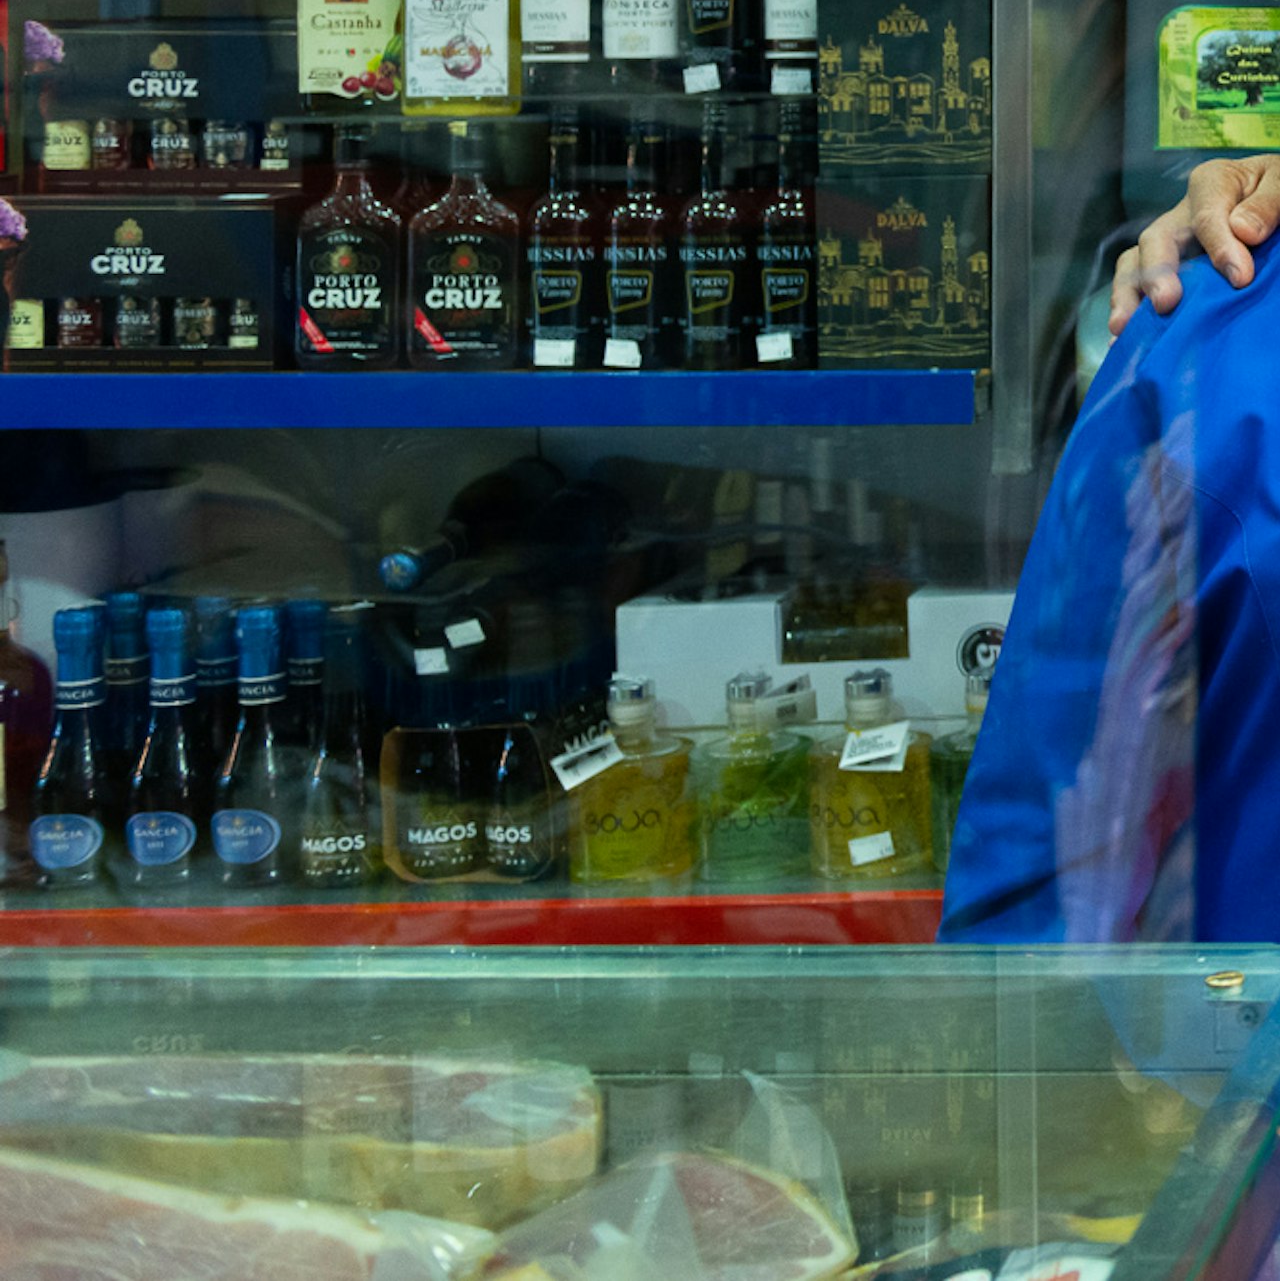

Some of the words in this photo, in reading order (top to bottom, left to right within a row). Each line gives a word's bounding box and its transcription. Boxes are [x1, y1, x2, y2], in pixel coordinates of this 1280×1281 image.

[310, 13, 383, 31] Castanha
[877, 19, 930, 35] DALVA
[141, 70, 187, 79] PORTO
[128, 77, 199, 98] CRUZ
[150, 136, 191, 150] CRUZ
[876, 212, 928, 229] DALVA
[104, 247, 153, 256] PORTO
[90, 255, 166, 276] CRUZ
[313, 274, 379, 288] PORTO
[432, 274, 500, 288] PORTO
[691, 276, 730, 287] PORTO
[307, 287, 383, 310] CRUZ
[424, 288, 504, 310] CRUZ
[407, 821, 478, 845] MAGOS
[302, 834, 367, 854] MAGOS
